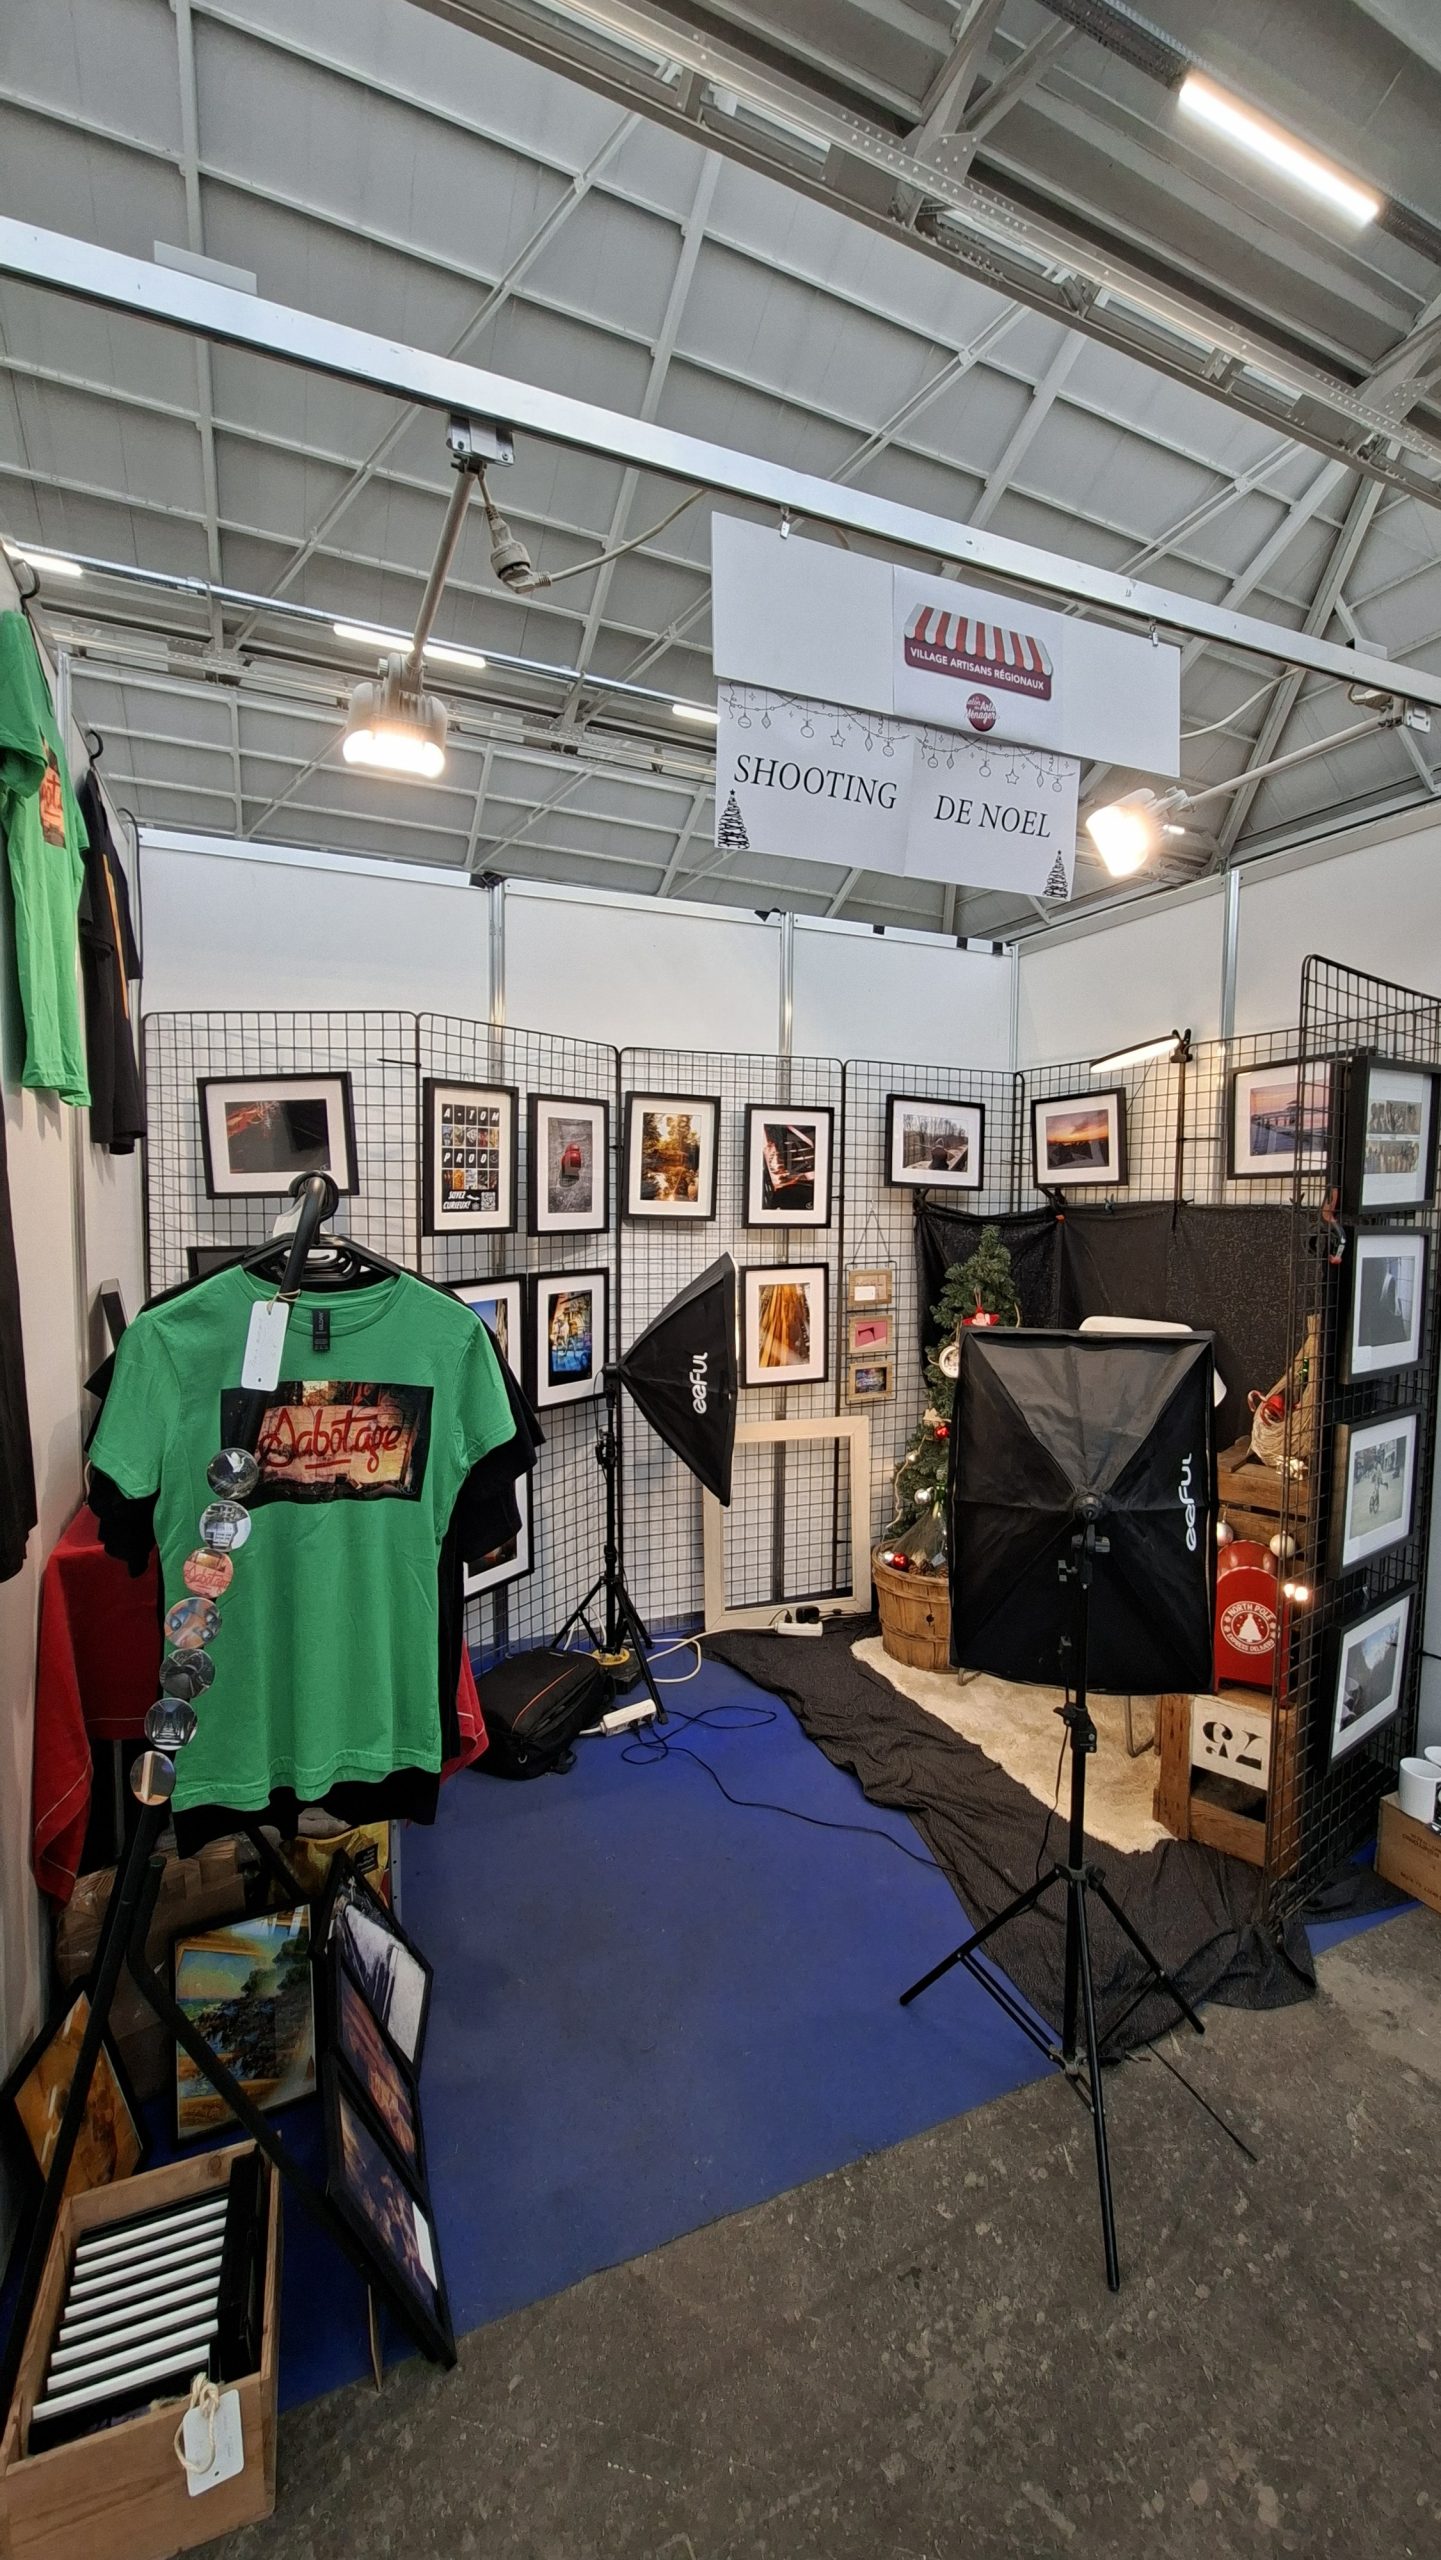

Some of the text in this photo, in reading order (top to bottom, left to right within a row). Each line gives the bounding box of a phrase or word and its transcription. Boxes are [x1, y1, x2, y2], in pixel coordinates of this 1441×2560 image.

[910, 647, 1045, 690] VILLAGE ARTISANS RÉGIONAUX
[733, 754, 898, 809] SHOOTING
[933, 794, 1051, 838] DE NOEL
[258, 1407, 402, 1473] Sabotage
[1227, 1603, 1273, 1621] NORTH POLE
[1226, 1633, 1249, 1651] EXPRESS
